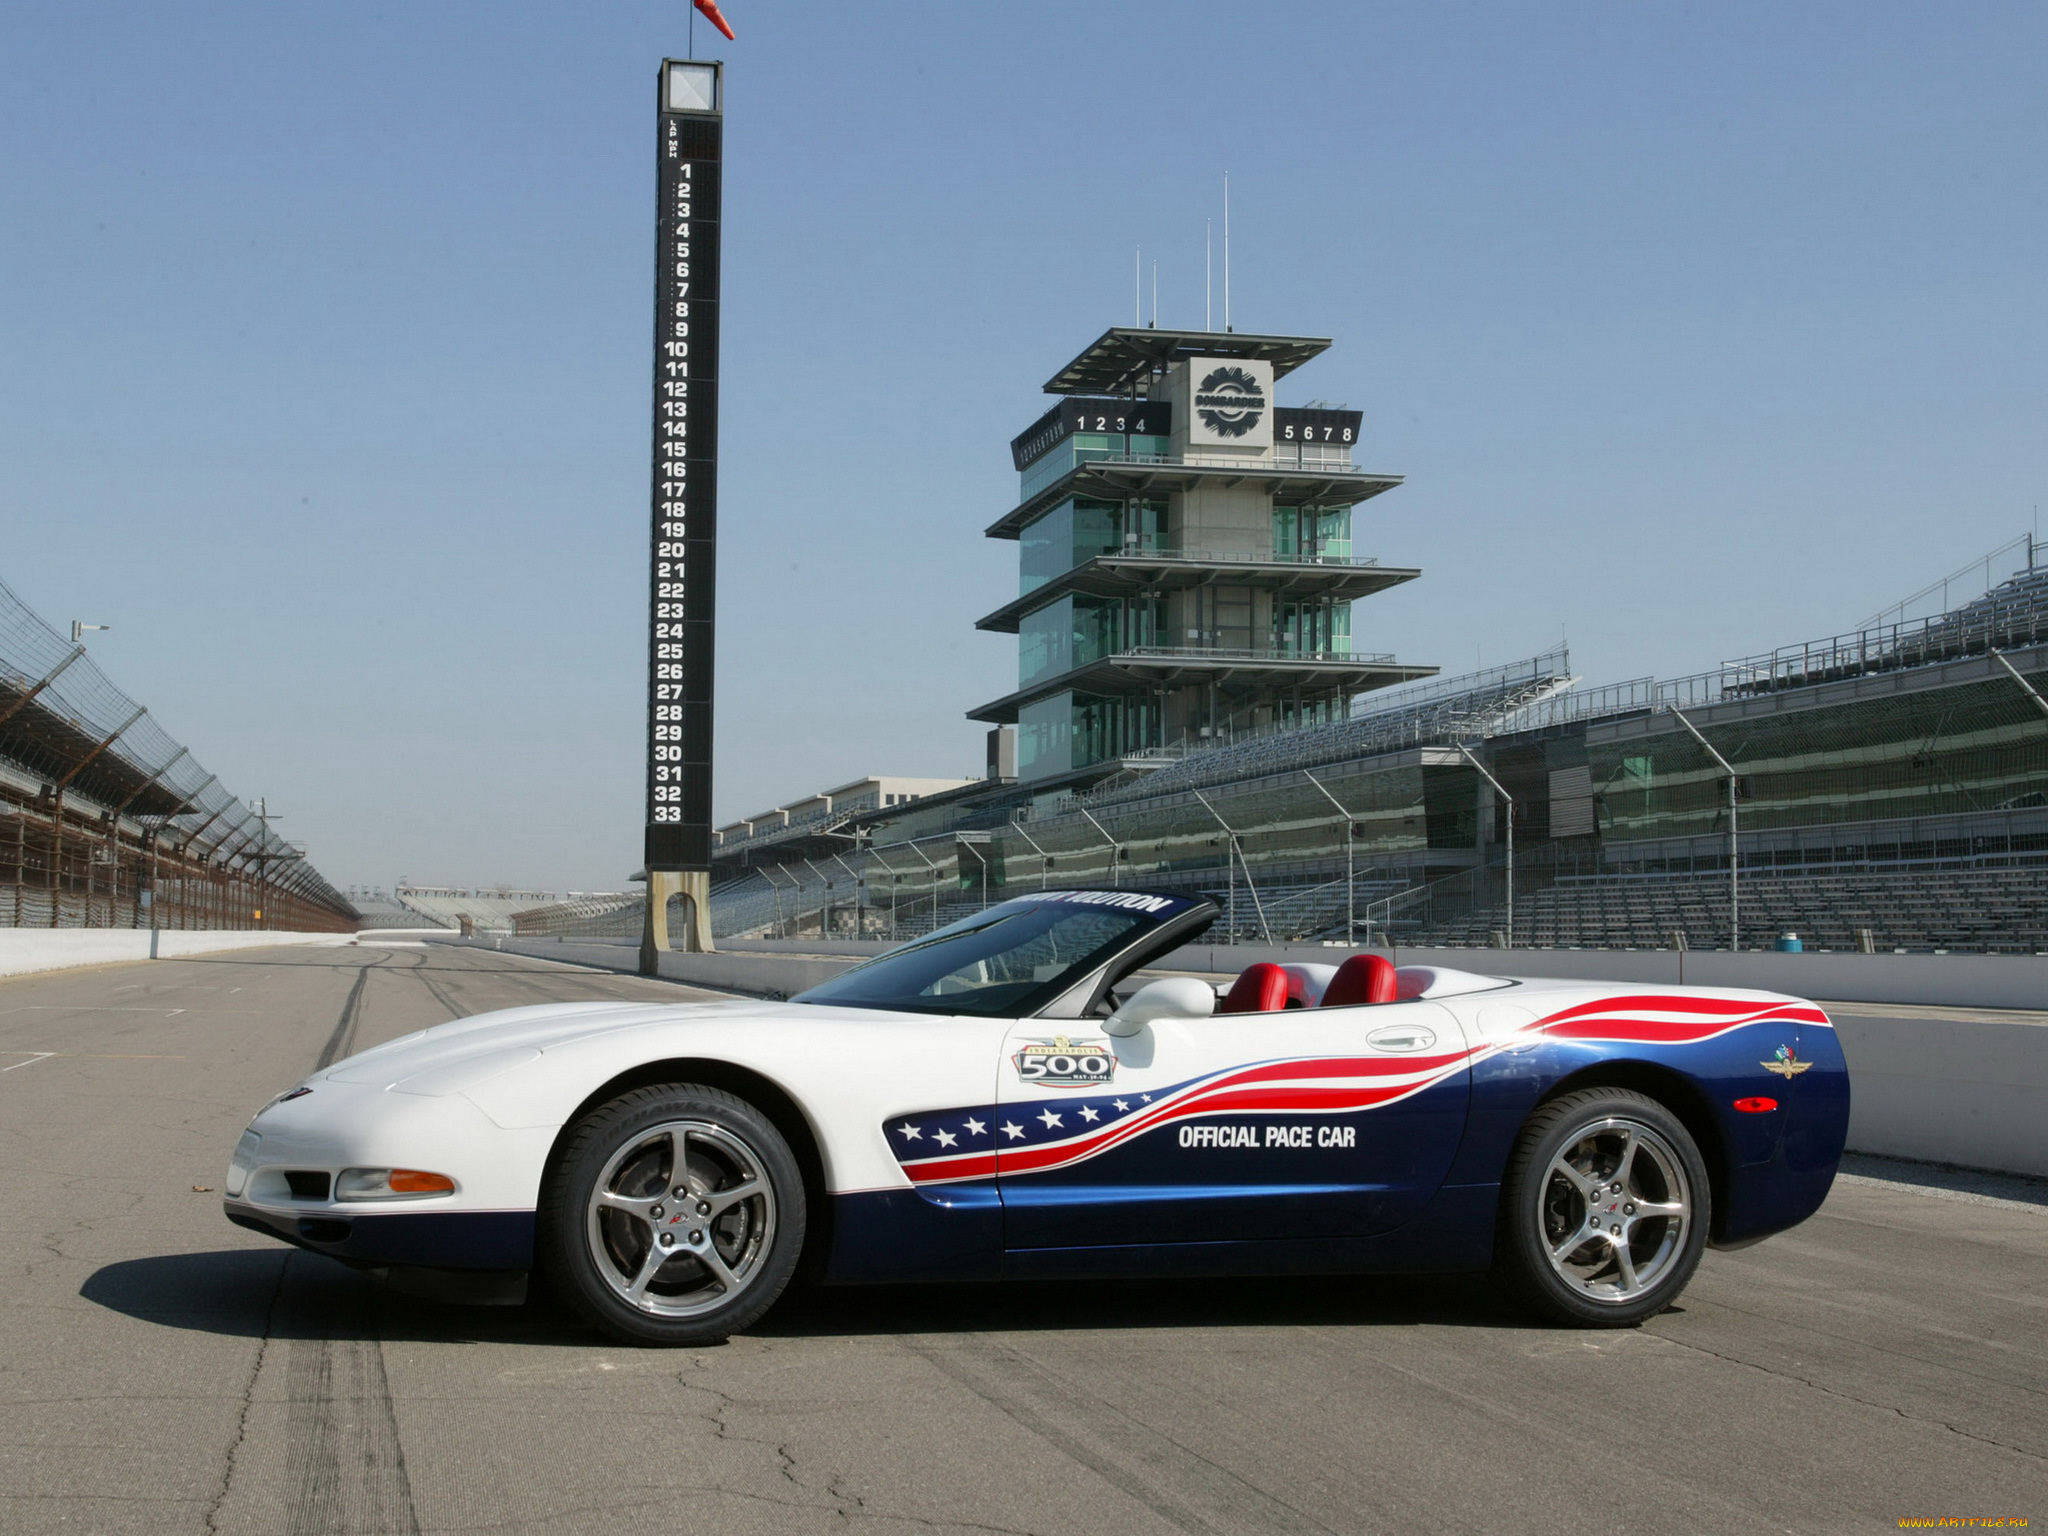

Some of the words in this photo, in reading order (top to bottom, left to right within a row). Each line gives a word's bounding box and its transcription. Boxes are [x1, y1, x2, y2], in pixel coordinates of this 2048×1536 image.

[669, 119, 677, 138] LAP
[668, 140, 679, 158] MPH
[680, 163, 691, 179] 1
[677, 183, 691, 198] 2
[677, 203, 690, 218] 3
[676, 223, 690, 238] 4
[677, 243, 690, 257] 5
[676, 262, 689, 277] 6
[676, 282, 689, 297] 7
[675, 302, 688, 317] 8
[675, 322, 688, 337] 9
[664, 342, 688, 357] 10
[665, 362, 688, 377] 11
[663, 381, 688, 397] 12
[662, 402, 687, 417] 13
[662, 421, 687, 437] 14
[1077, 415, 1085, 430] 1
[1096, 416, 1106, 431] 2
[1116, 417, 1125, 431] 3
[1135, 419, 1145, 432] 4
[1284, 425, 1294, 439] 5
[1304, 426, 1313, 440] 6
[1323, 427, 1333, 441] 7
[1342, 428, 1352, 442] 8
[662, 442, 687, 457] 15
[661, 462, 686, 477] 16
[661, 482, 686, 497] 17
[661, 502, 686, 517] 18
[660, 522, 686, 537] 19
[658, 542, 685, 558] 20
[658, 562, 685, 578] 21
[658, 583, 685, 598] 22
[657, 603, 684, 618] 23
[656, 623, 684, 639] 24
[657, 643, 684, 659] 25
[657, 664, 683, 679] 26
[656, 684, 683, 700] 27
[656, 705, 683, 720] 28
[655, 725, 682, 741] 29
[655, 746, 682, 761] 30
[655, 766, 682, 781] 31
[654, 786, 682, 801] 32
[654, 806, 682, 822] 33
[1021, 1055, 1109, 1079] 500
[1178, 1125, 1261, 1148] OFFICIAL
[1265, 1126, 1313, 1148] PACE
[1317, 1126, 1356, 1148] CAR
